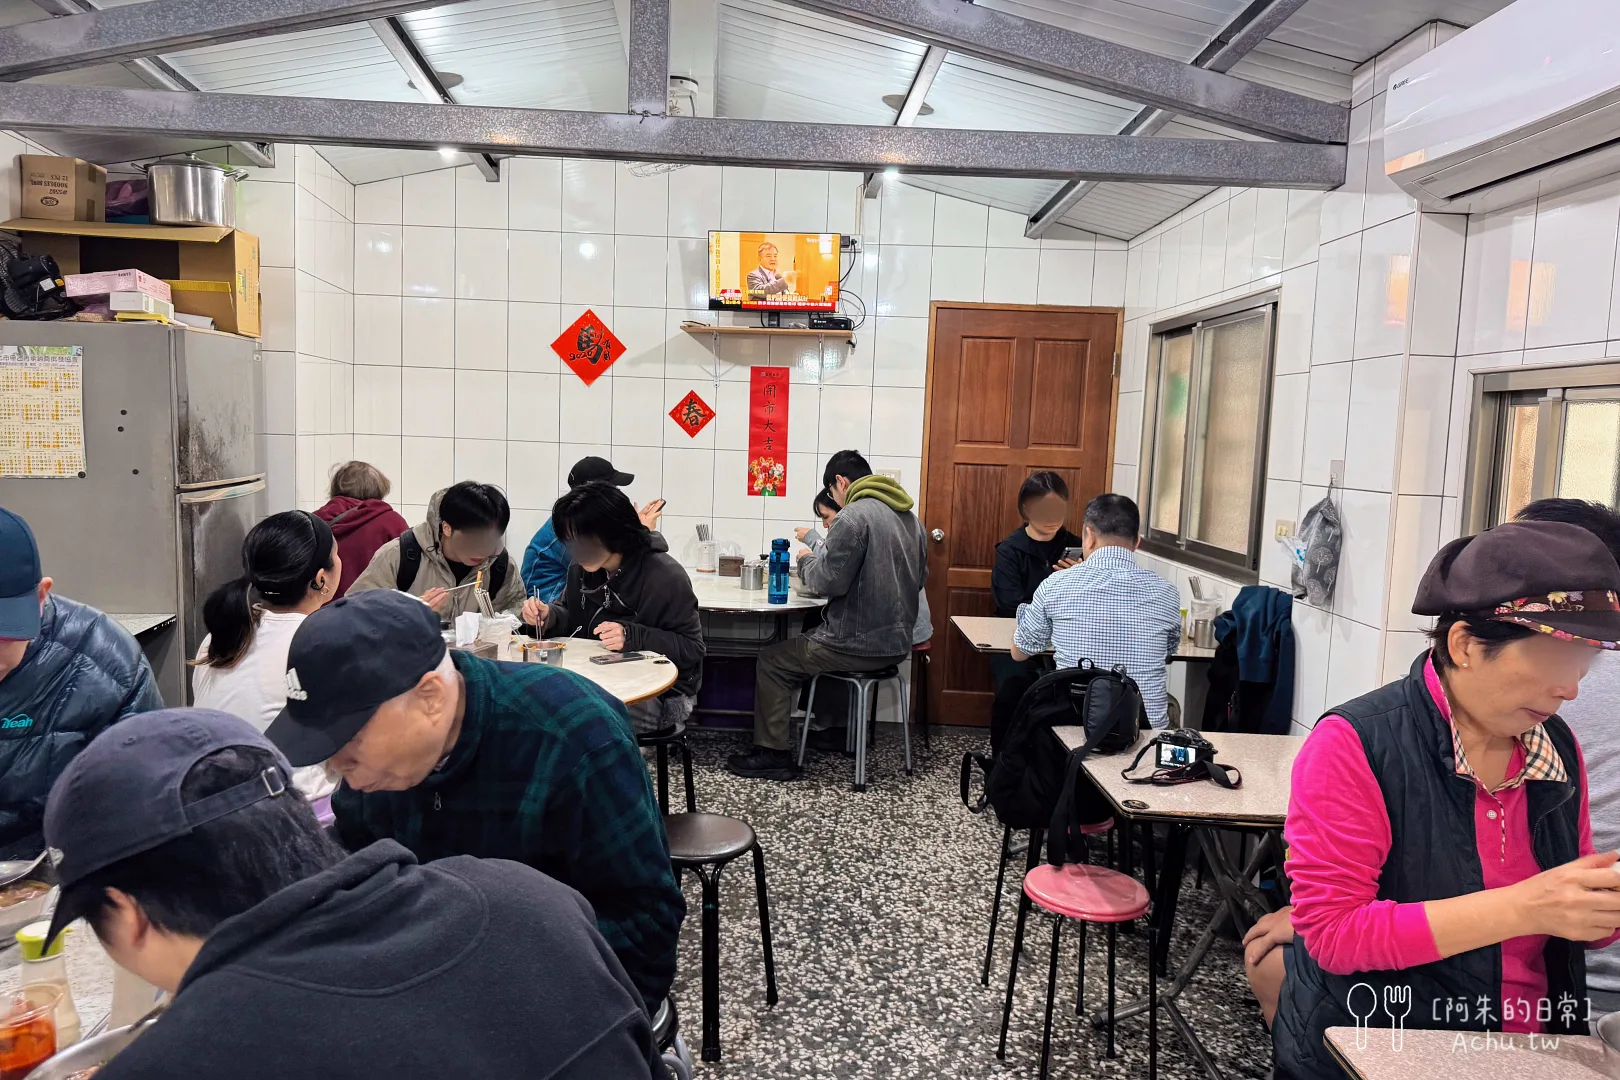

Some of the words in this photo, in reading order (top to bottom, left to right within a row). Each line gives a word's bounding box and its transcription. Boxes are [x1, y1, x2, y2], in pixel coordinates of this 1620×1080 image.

[682, 398, 707, 427] 春
[762, 384, 777, 451] 開市大吉
